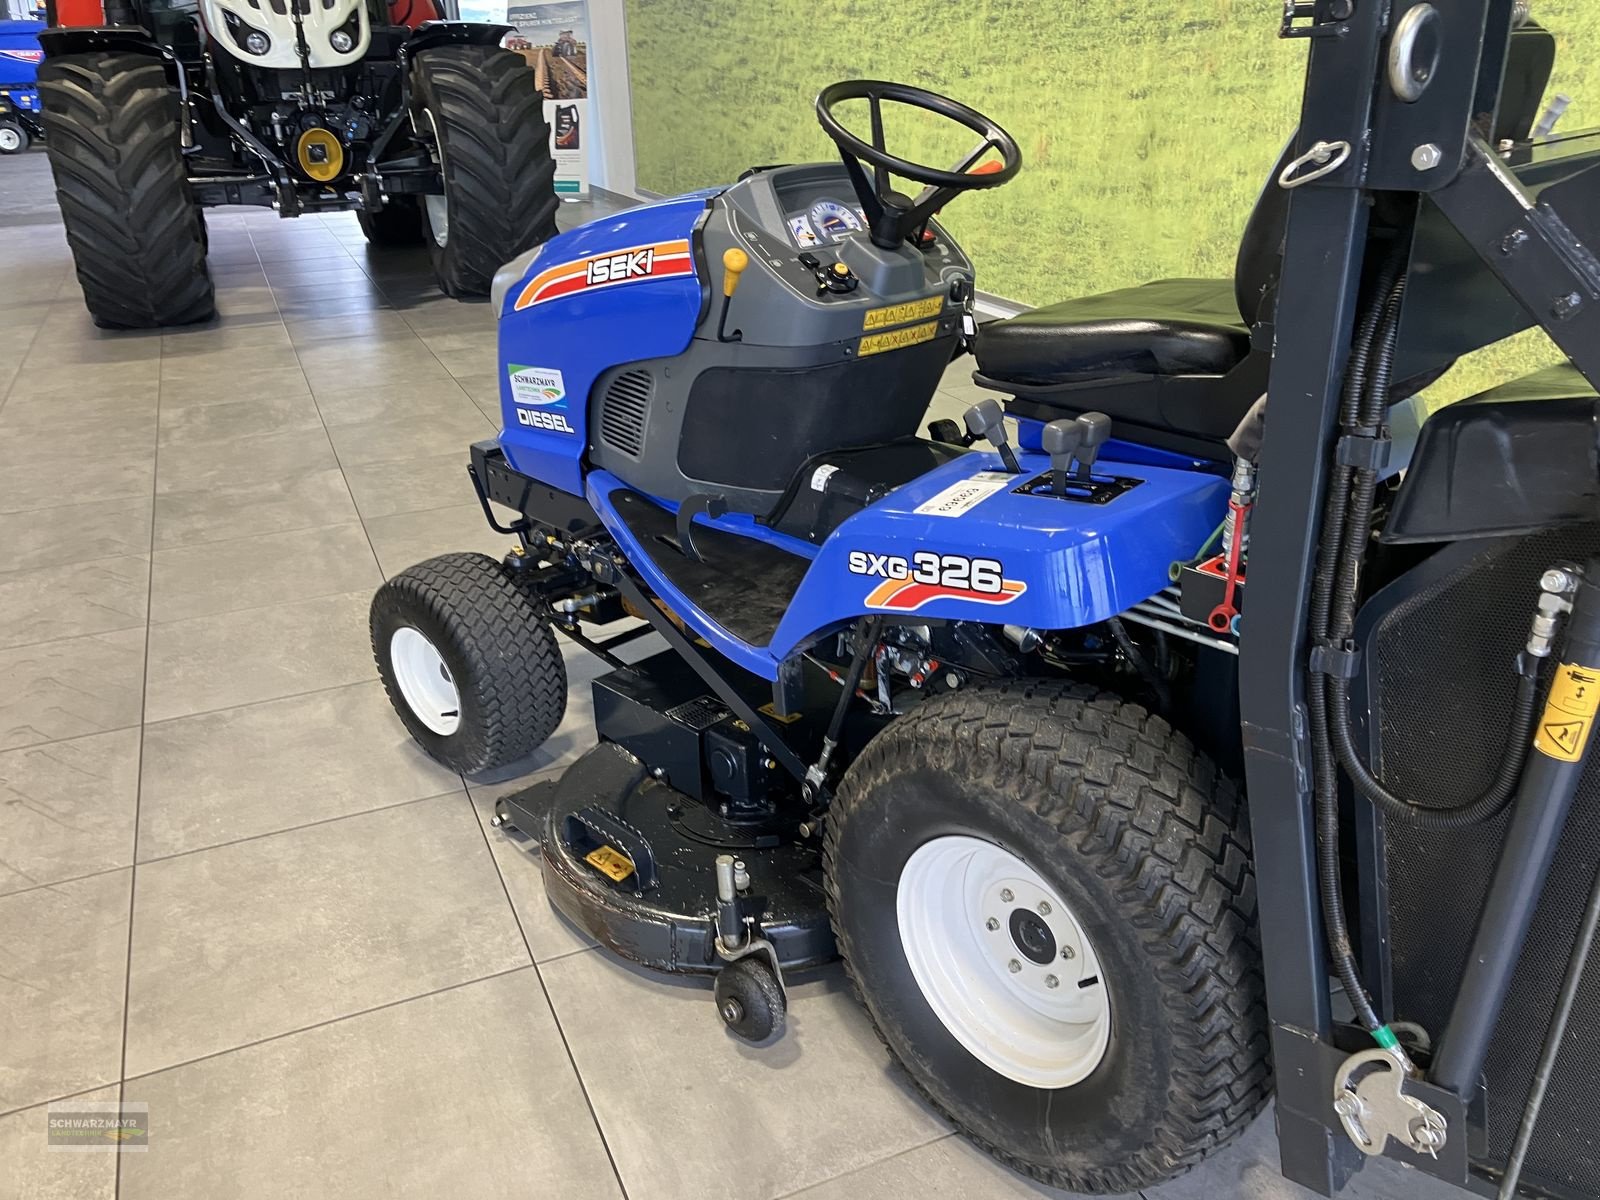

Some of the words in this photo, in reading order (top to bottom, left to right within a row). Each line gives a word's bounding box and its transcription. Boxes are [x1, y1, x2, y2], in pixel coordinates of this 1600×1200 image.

[586, 248, 654, 286] ISEKI
[516, 407, 575, 434] DIESEL
[848, 550, 909, 580] SXG
[912, 551, 1003, 594] 326
